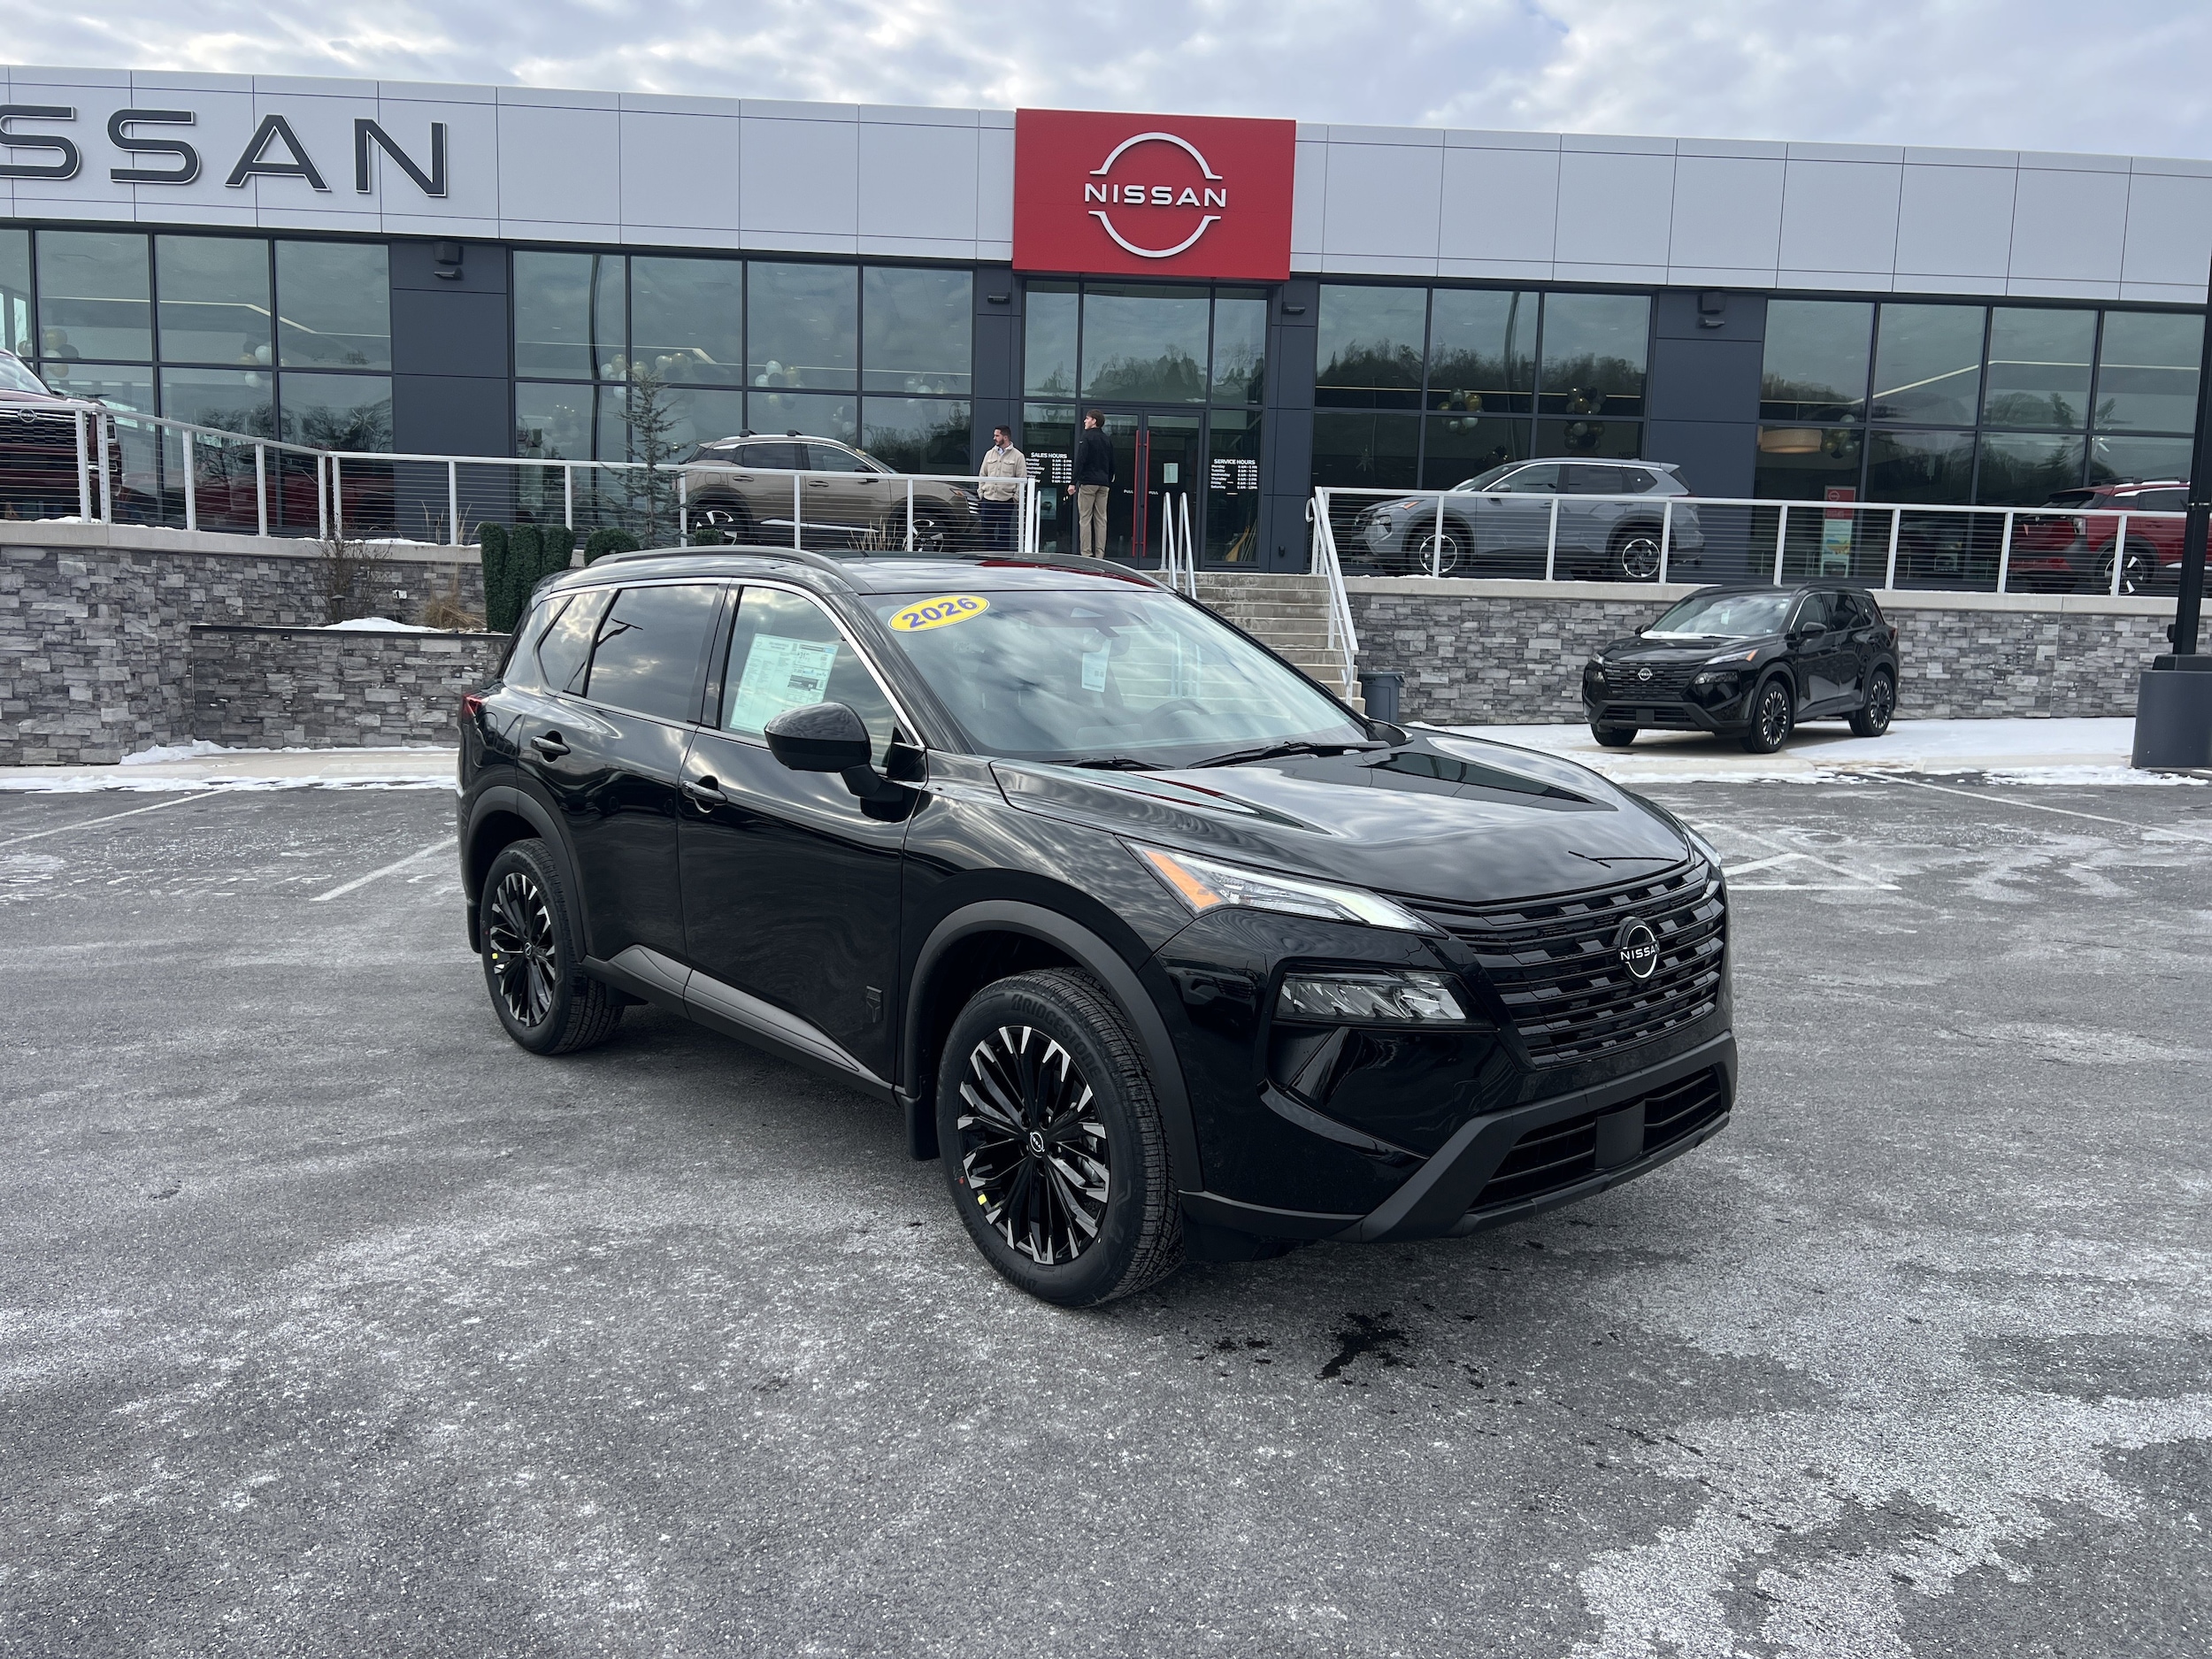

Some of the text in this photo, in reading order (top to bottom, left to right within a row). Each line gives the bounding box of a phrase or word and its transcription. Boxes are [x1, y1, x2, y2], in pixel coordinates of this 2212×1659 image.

[1084, 182, 1226, 209] NISSAN
[902, 596, 979, 629] 2026
[1620, 944, 1660, 960] NISSAN
[1010, 993, 1102, 1079] BRIDGESTONE
